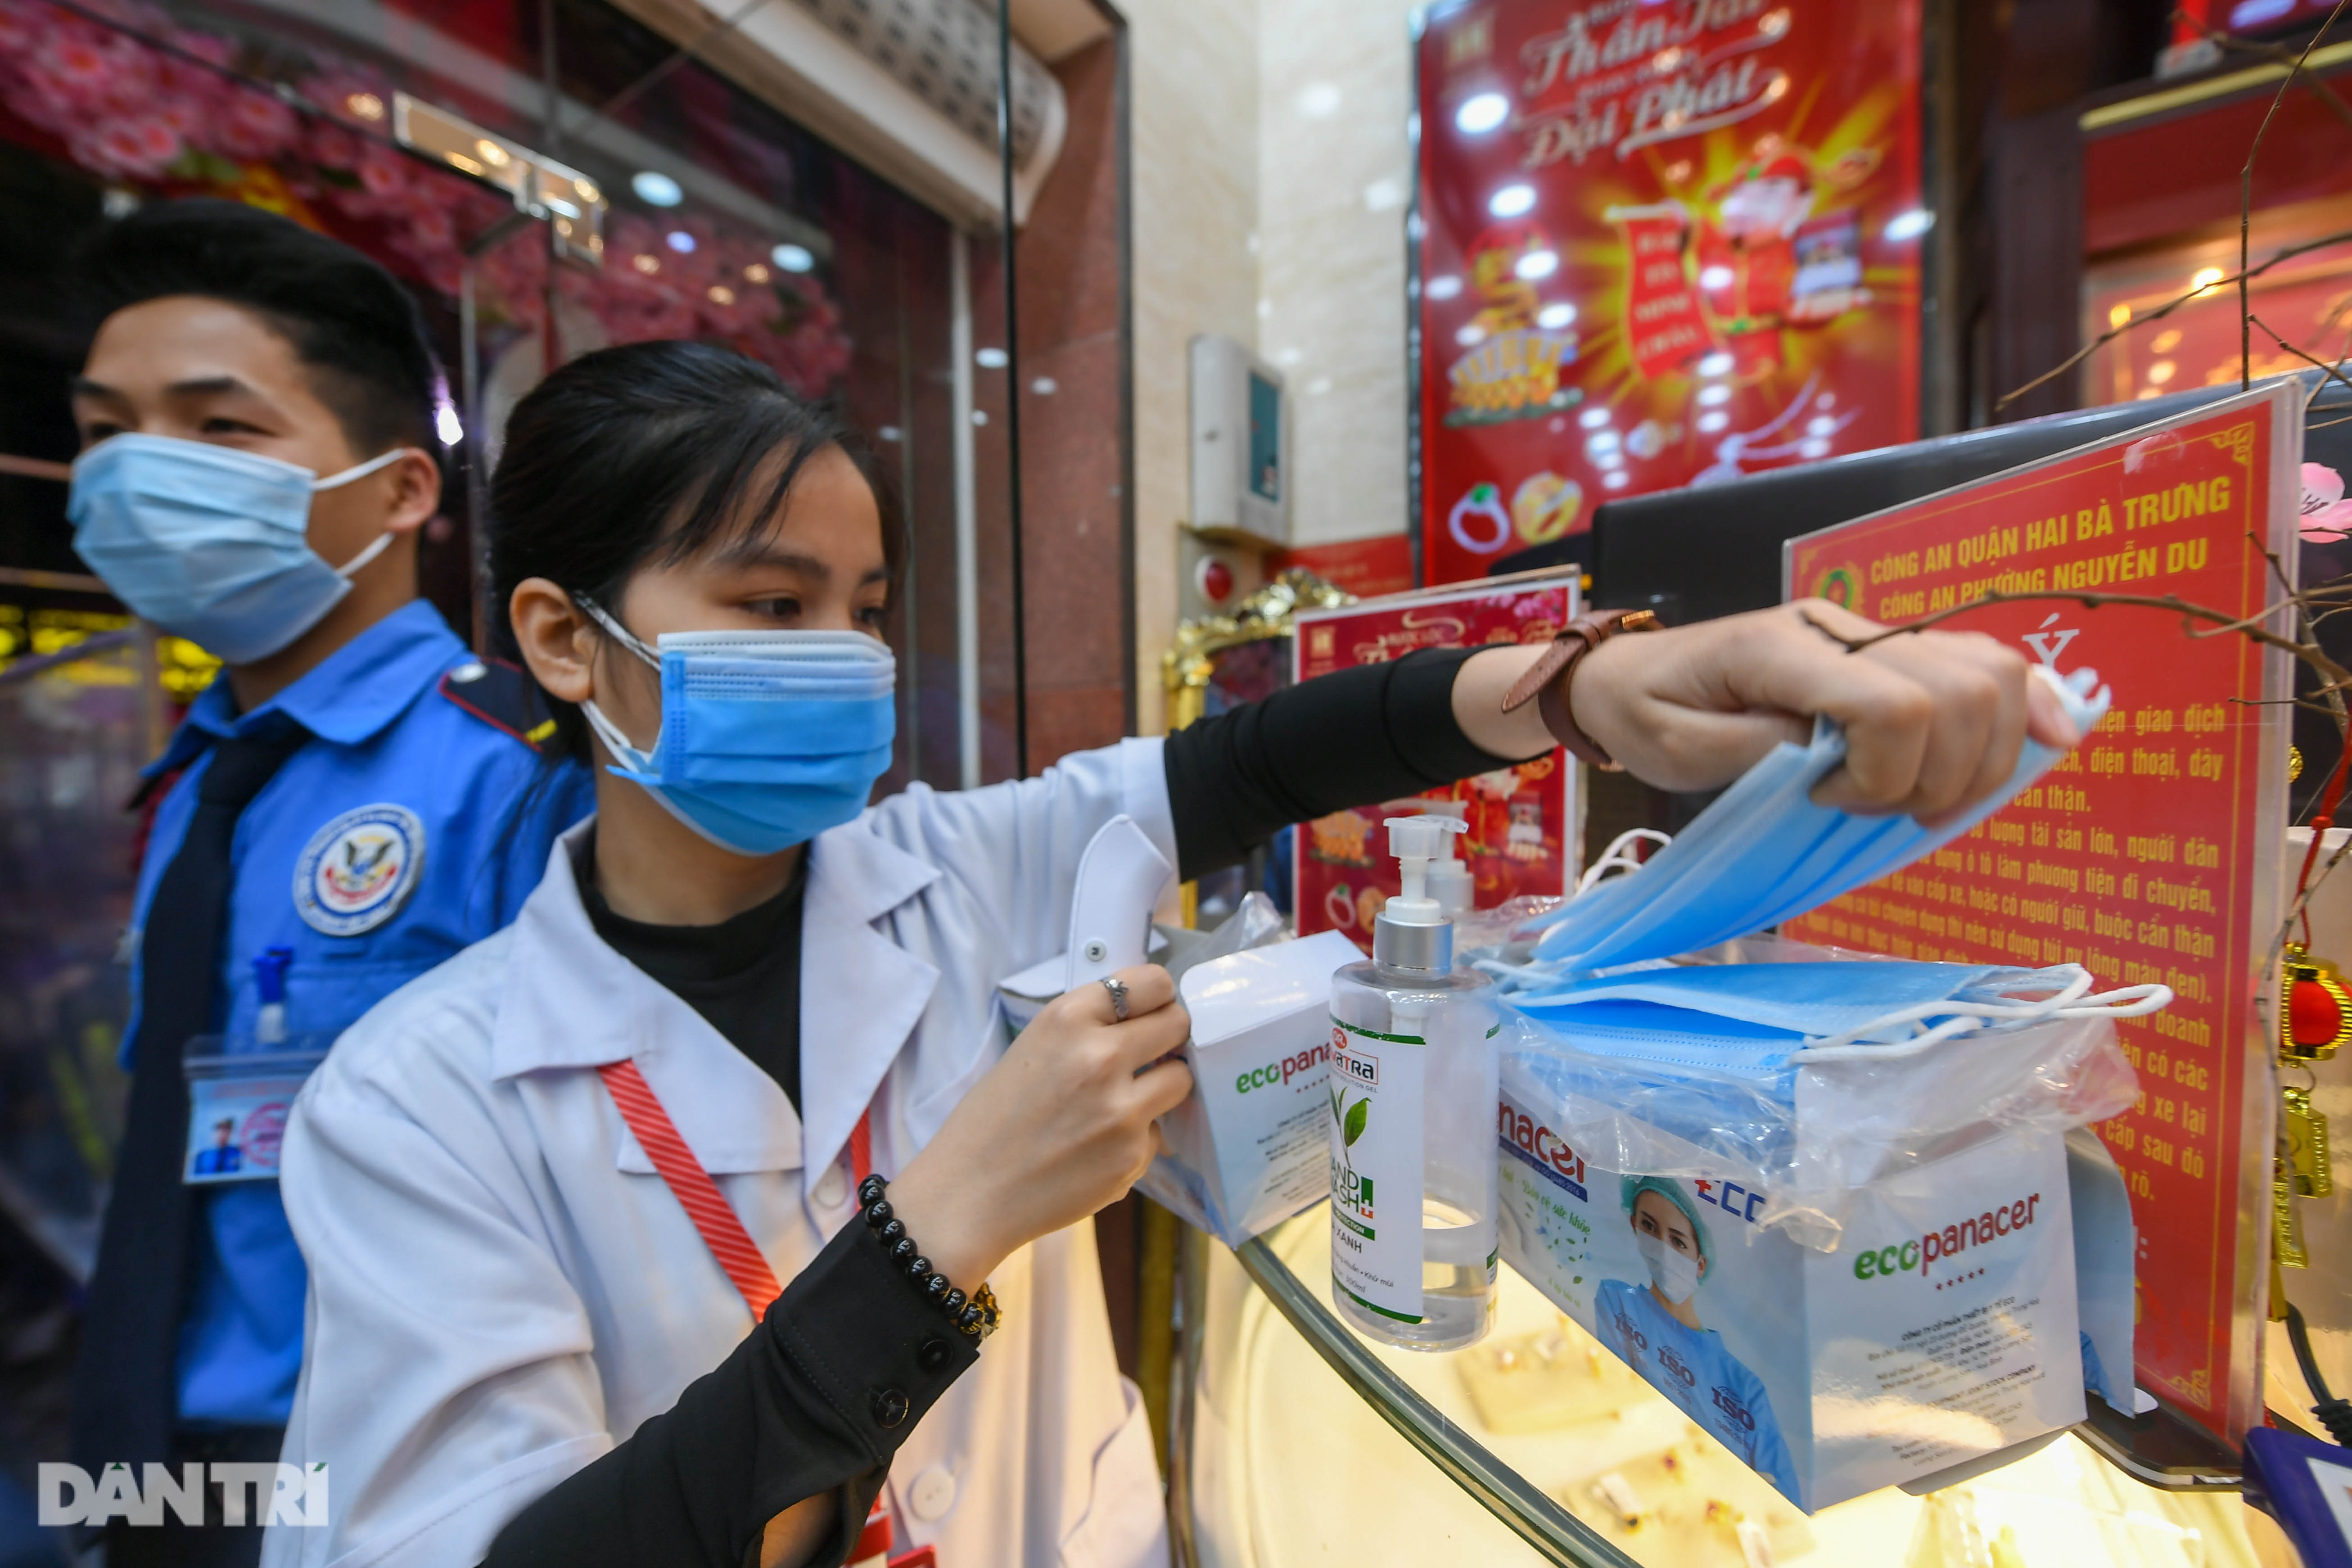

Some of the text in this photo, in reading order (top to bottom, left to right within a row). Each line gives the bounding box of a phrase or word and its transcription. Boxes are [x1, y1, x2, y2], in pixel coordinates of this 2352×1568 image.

[1871, 475, 2231, 584] CÔNG AN QUẬN HAI BÀ TRƯNG
[1879, 537, 2208, 620] CÔNG AN PHƯỜNG NGUYỄN DU
[2135, 705, 2173, 736] giao
[2183, 703, 2225, 739] dịch
[2090, 746, 2125, 779] điện
[2131, 747, 2180, 782] thoại,
[2048, 784, 2091, 817] thận.
[1989, 817, 2025, 847] lượng
[2031, 820, 2050, 847] tài
[2056, 820, 2082, 851] sản
[2090, 826, 2119, 859] lớn,
[2126, 833, 2176, 863] người
[2184, 836, 2219, 868] dân
[1997, 853, 2022, 881] làm
[2027, 859, 2078, 893] phương
[2085, 867, 2115, 901] tiện
[2146, 875, 2217, 916] chuyển,
[1968, 884, 1999, 917] hoặc
[2002, 891, 2018, 917] có
[2020, 899, 2059, 925] người
[2063, 903, 2090, 935] giữ,
[2094, 907, 2133, 945] buộc
[2138, 912, 2170, 949] cẩn
[2174, 923, 2215, 962] thận
[2007, 929, 2041, 962] dụng
[2086, 946, 2120, 983] lông
[2124, 958, 2162, 985] màu
[2155, 1007, 2210, 1048] doanh
[2146, 1048, 2168, 1078] có
[2174, 1057, 2210, 1091] các
[2153, 1095, 2175, 1123] xe
[2182, 1099, 2208, 1139] lại
[2105, 1114, 2205, 1179] cấp sau đó
[2131, 1169, 2155, 1201] rõ.
[1853, 1193, 2040, 1281] ecopanacer
[1657, 1347, 1696, 1387] ISO
[1711, 1386, 1755, 1431] ISO
